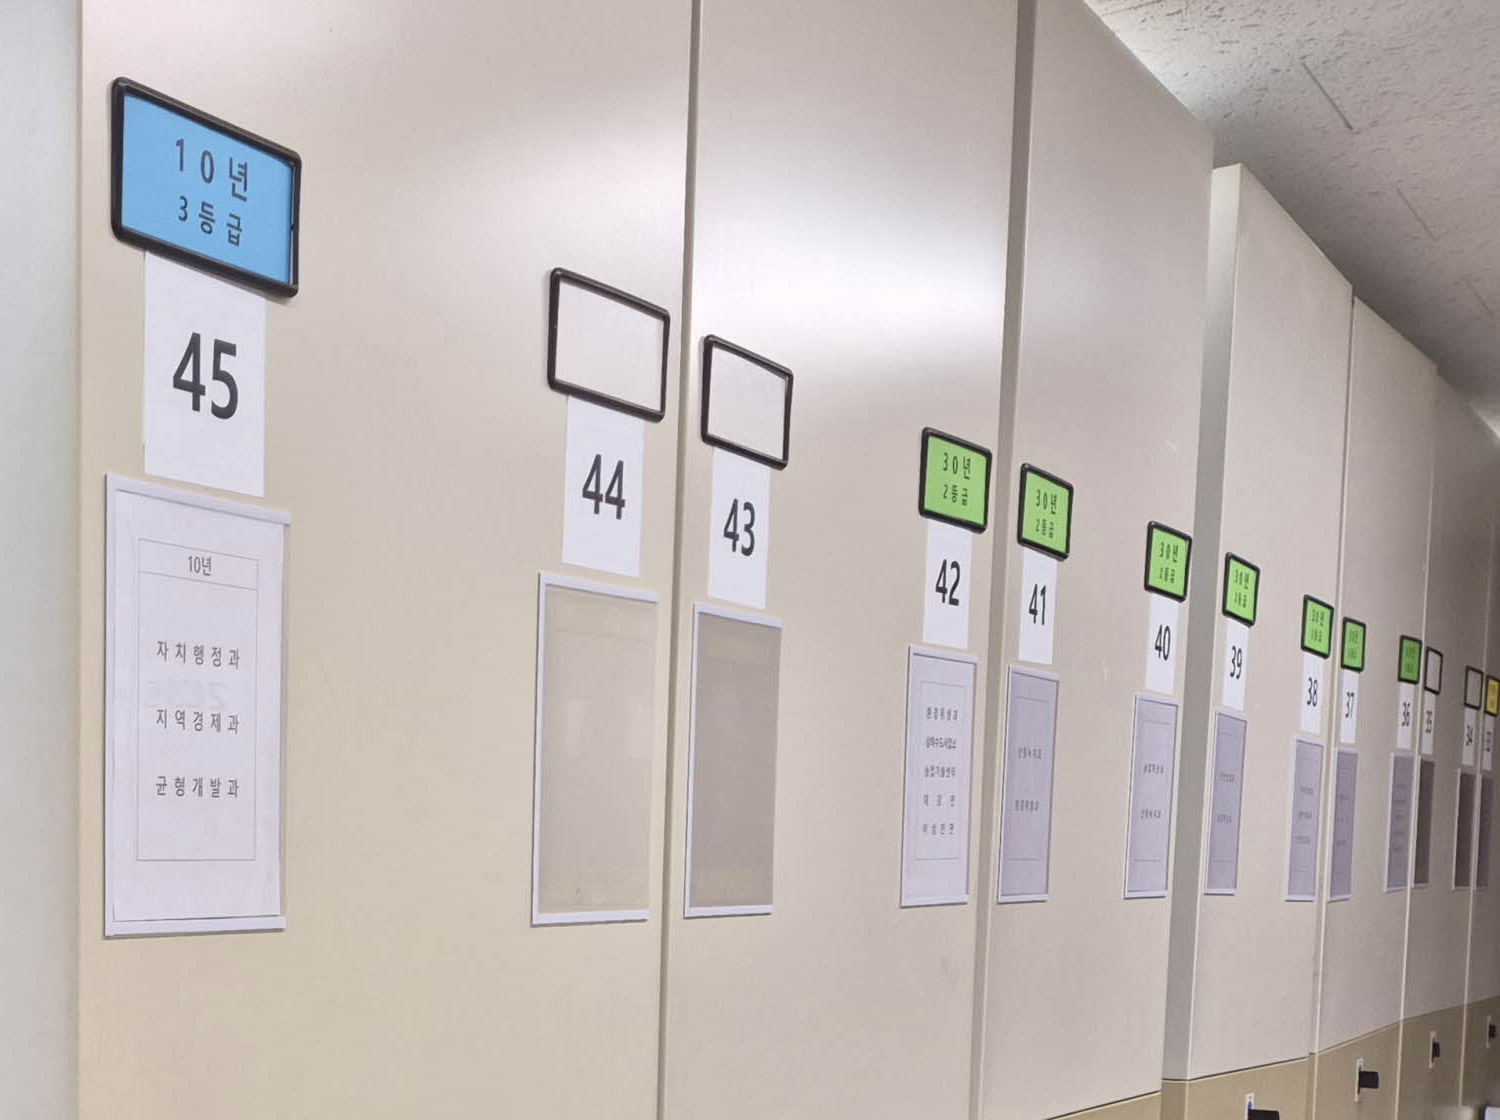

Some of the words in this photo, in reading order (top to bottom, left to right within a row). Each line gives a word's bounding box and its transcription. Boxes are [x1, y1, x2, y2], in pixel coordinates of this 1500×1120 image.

[176, 138, 247, 202] 10년
[178, 195, 242, 247] 3등급
[173, 331, 238, 420] 45
[942, 452, 971, 480] 30년
[582, 454, 625, 519] 44
[942, 484, 969, 506] 2등급
[1036, 488, 1057, 515] 30년
[723, 498, 755, 556] 43
[187, 555, 212, 576] 10년
[935, 558, 961, 606] 42
[1028, 583, 1046, 626] 41
[1154, 623, 1171, 661] 40
[1229, 644, 1243, 680] 39
[1306, 676, 1318, 707] 38
[1345, 691, 1355, 718] 37
